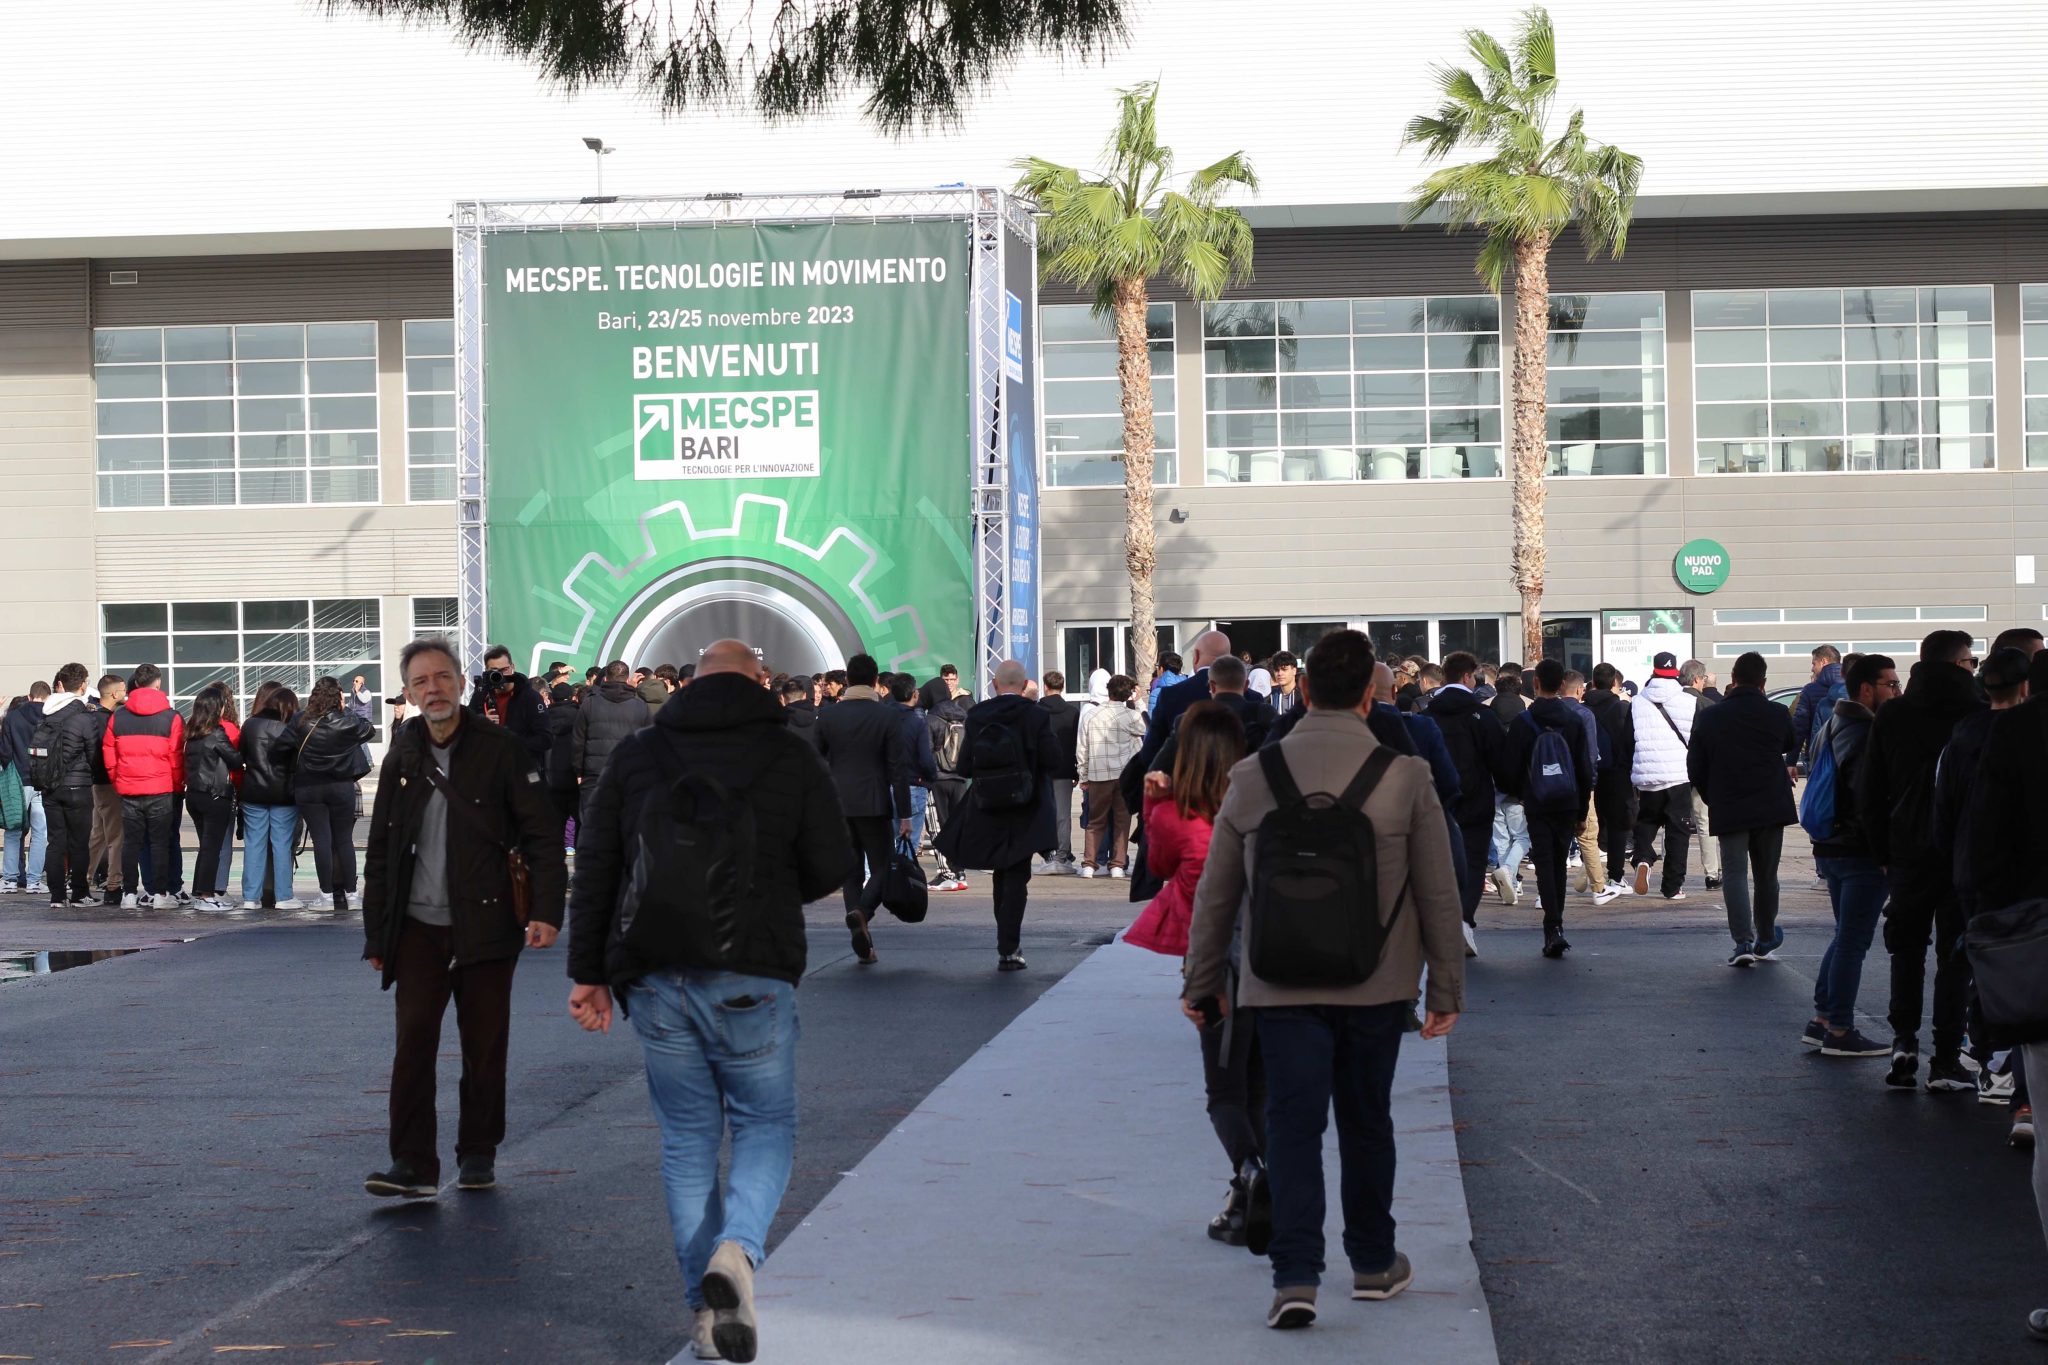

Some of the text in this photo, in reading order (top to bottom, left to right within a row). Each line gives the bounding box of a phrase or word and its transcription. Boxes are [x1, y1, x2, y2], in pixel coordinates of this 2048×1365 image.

[506, 257, 947, 293] MECSPE. TECNOLOGIE IN MOVIMENTO
[598, 305, 854, 331] Bari, 23/25 novembre 2023
[632, 342, 819, 379] BENVENUTI
[680, 395, 814, 430] MECSPE
[681, 436, 739, 460] BARI
[682, 463, 815, 475] TECNOLOGIE PER L'INNOVAZIONE
[1684, 555, 1721, 566] NUOVO
[1691, 566, 1715, 576] PAD.
